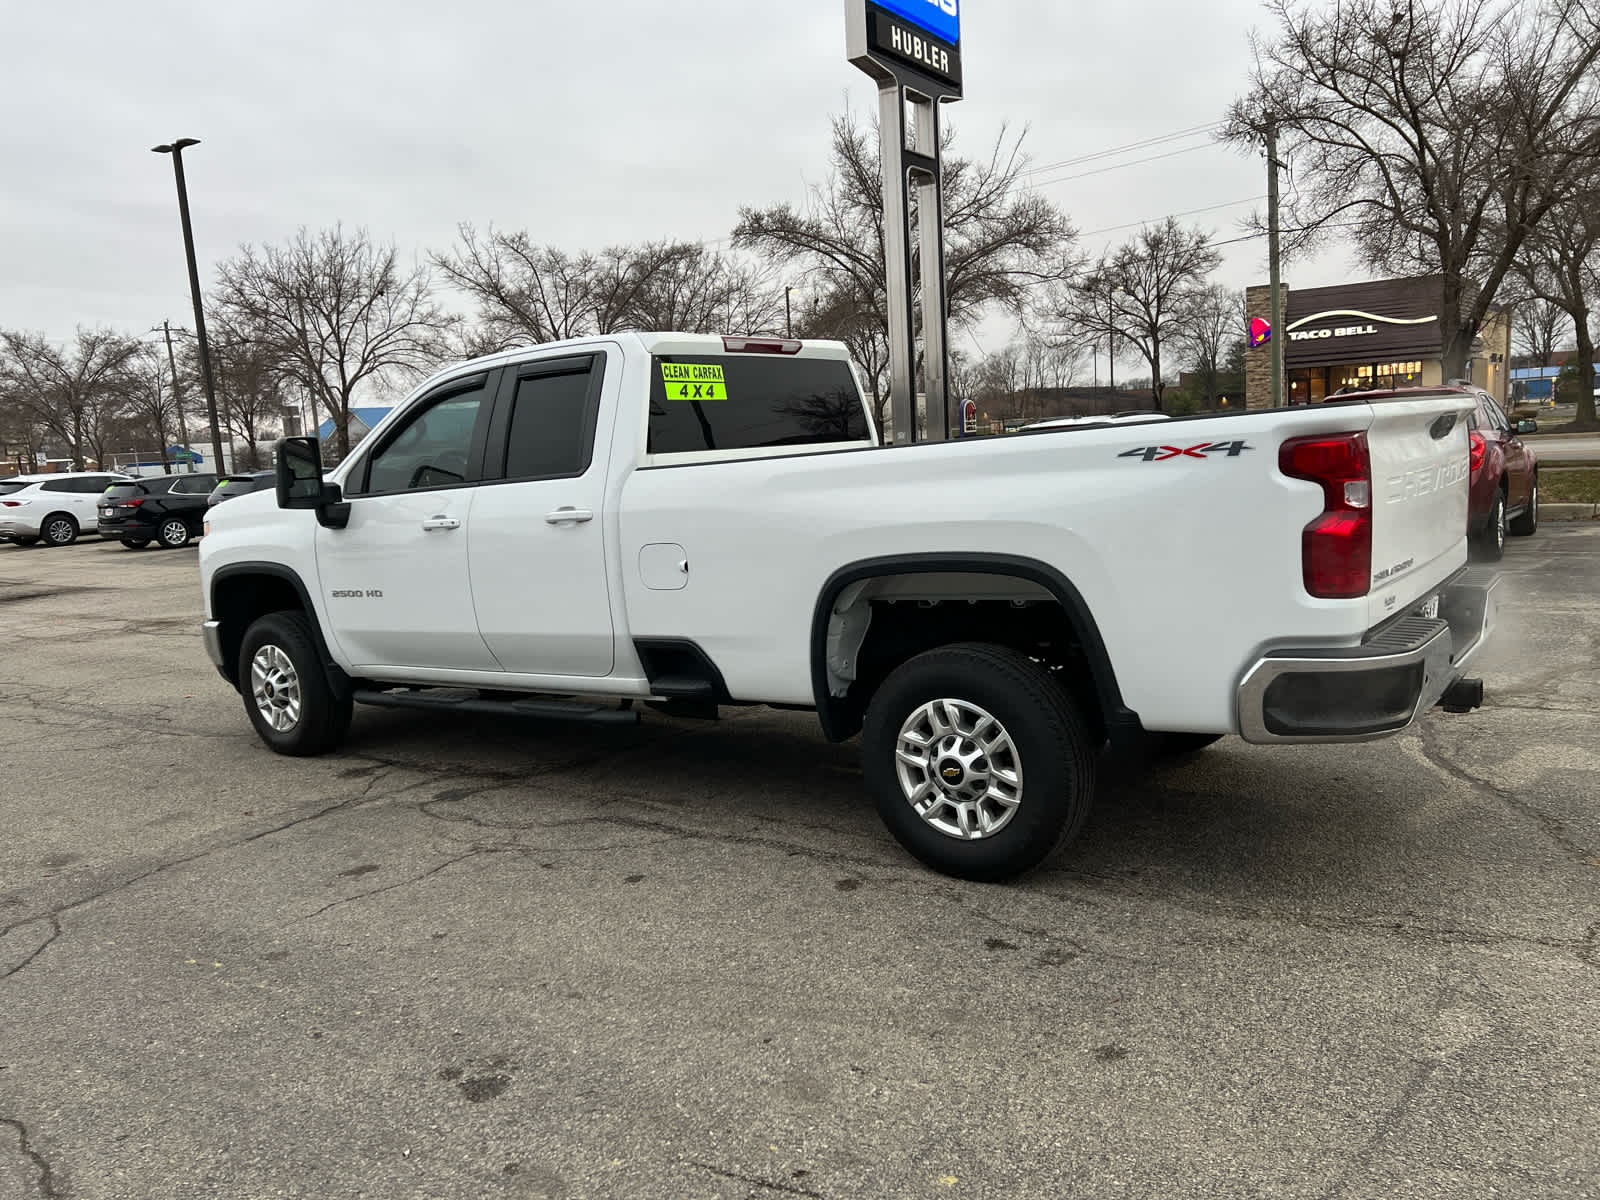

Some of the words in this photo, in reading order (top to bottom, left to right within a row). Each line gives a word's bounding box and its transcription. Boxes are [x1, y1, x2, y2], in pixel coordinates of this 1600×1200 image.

[891, 25, 949, 73] HUBLER
[1288, 331, 1331, 340] TACO
[1334, 325, 1378, 336] BELL
[664, 366, 690, 378] CLEAN
[693, 367, 722, 380] CARFAX
